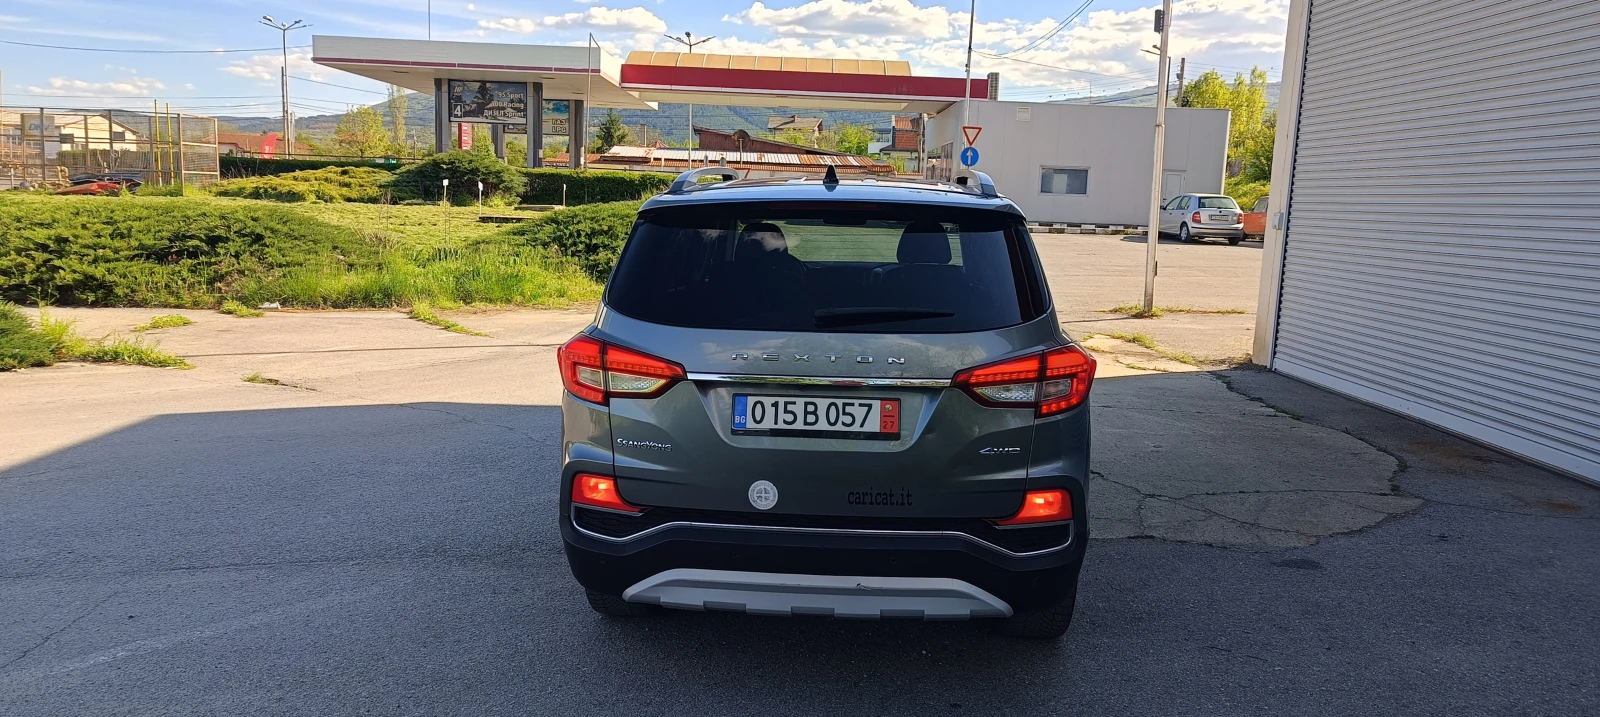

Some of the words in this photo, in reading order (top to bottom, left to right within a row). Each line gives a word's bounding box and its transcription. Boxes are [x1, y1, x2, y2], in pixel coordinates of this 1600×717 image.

[507, 91, 524, 99] Sport
[453, 104, 462, 117] 4
[503, 101, 524, 109] Racing
[505, 110, 524, 118] Sprint
[731, 351, 906, 365] REXTON
[734, 415, 746, 424] BG
[882, 420, 895, 430] 27
[978, 446, 1021, 455] 4WD
[847, 486, 913, 507] caricat.it
